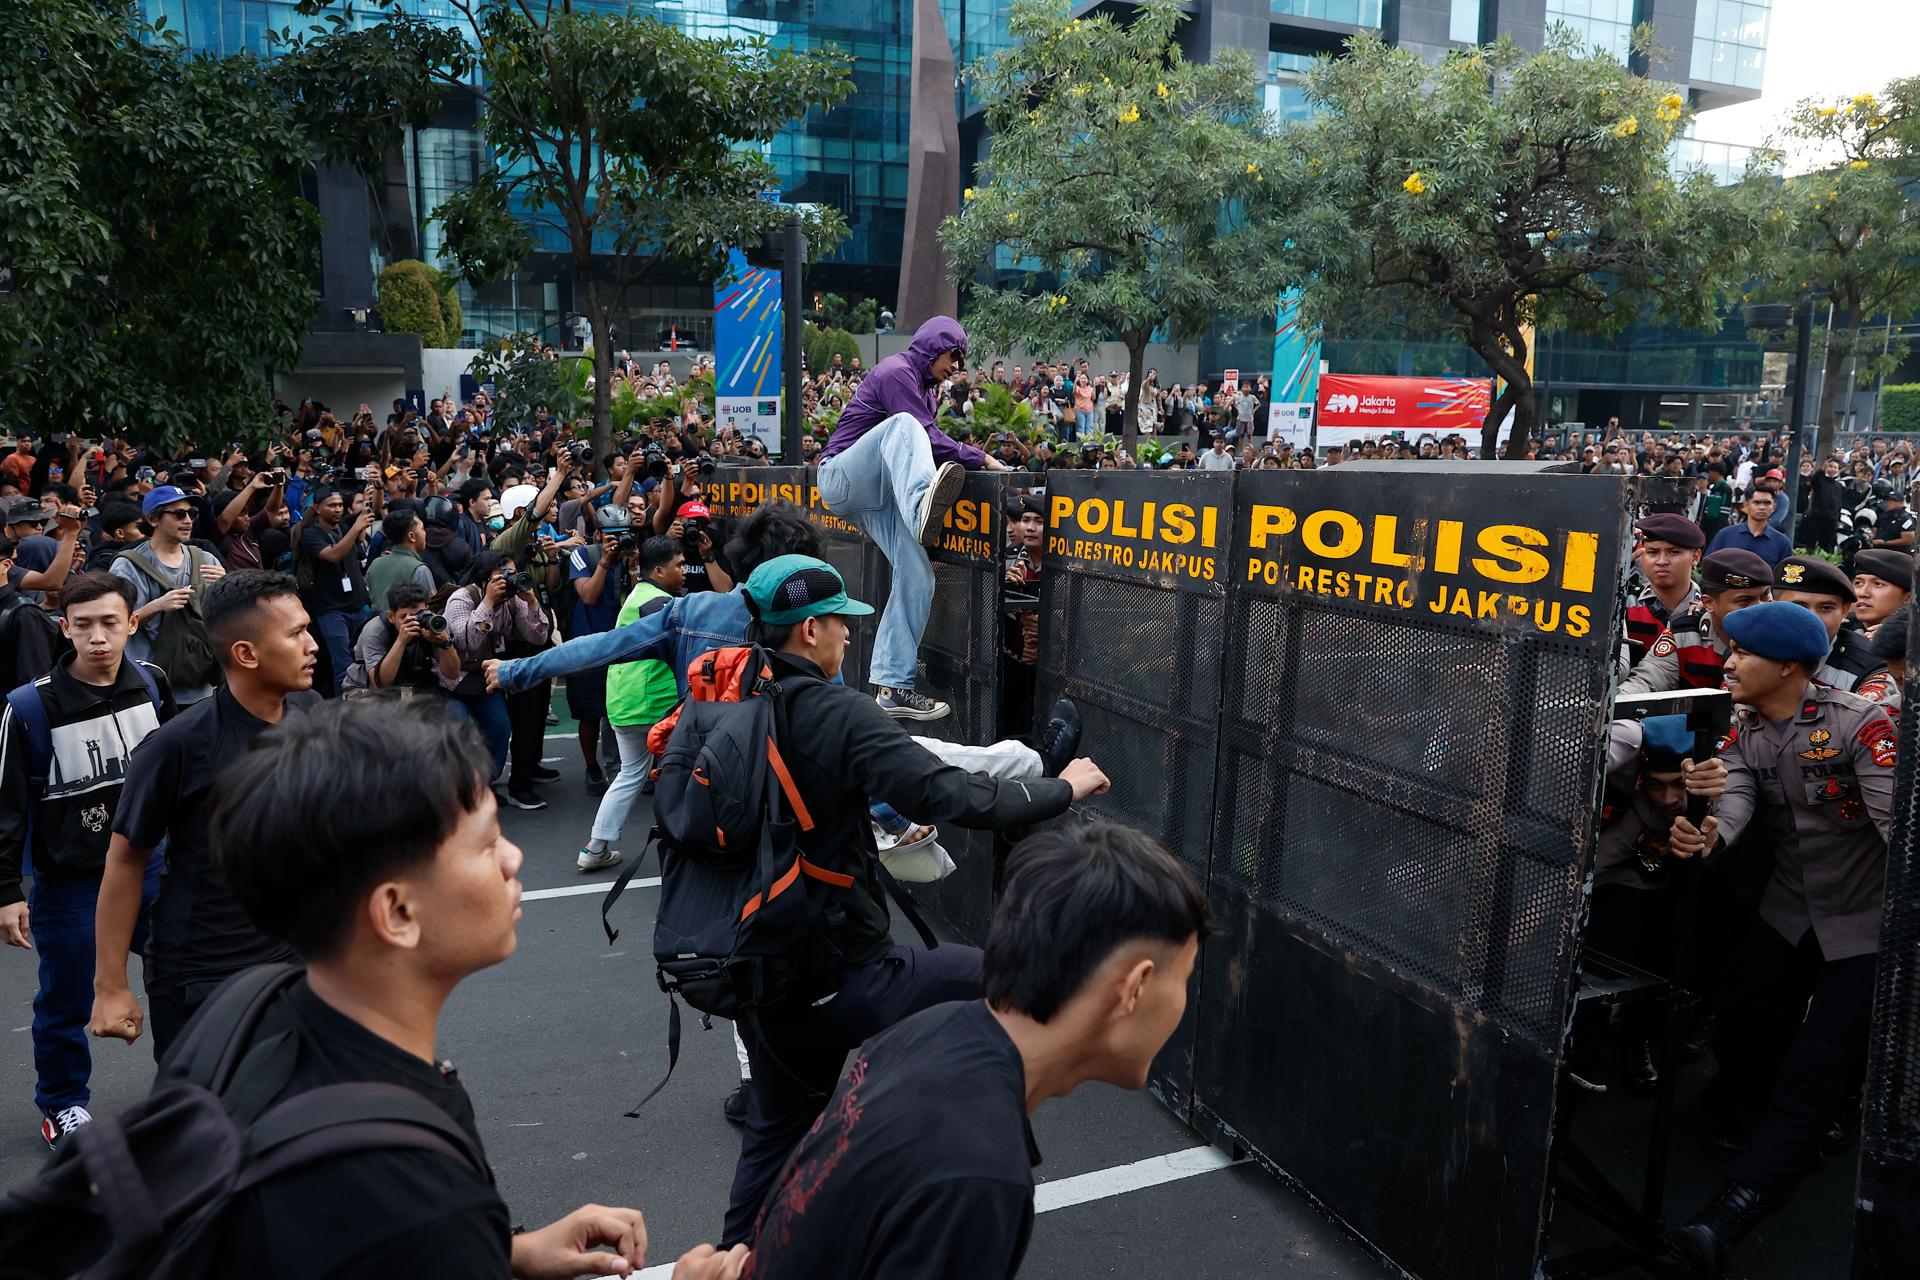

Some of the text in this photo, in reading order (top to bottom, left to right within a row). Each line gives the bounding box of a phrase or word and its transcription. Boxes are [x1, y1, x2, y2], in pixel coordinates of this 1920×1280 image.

[1360, 395, 1396, 406] Jakarta
[943, 499, 990, 534] ISI
[1050, 495, 1218, 547] POLISI
[684, 564, 705, 574] BLIK
[1049, 536, 1215, 580] POLRESTRO JAKPUS
[1249, 504, 1599, 593] POLISI
[1429, 585, 1591, 638] JAKPUS
